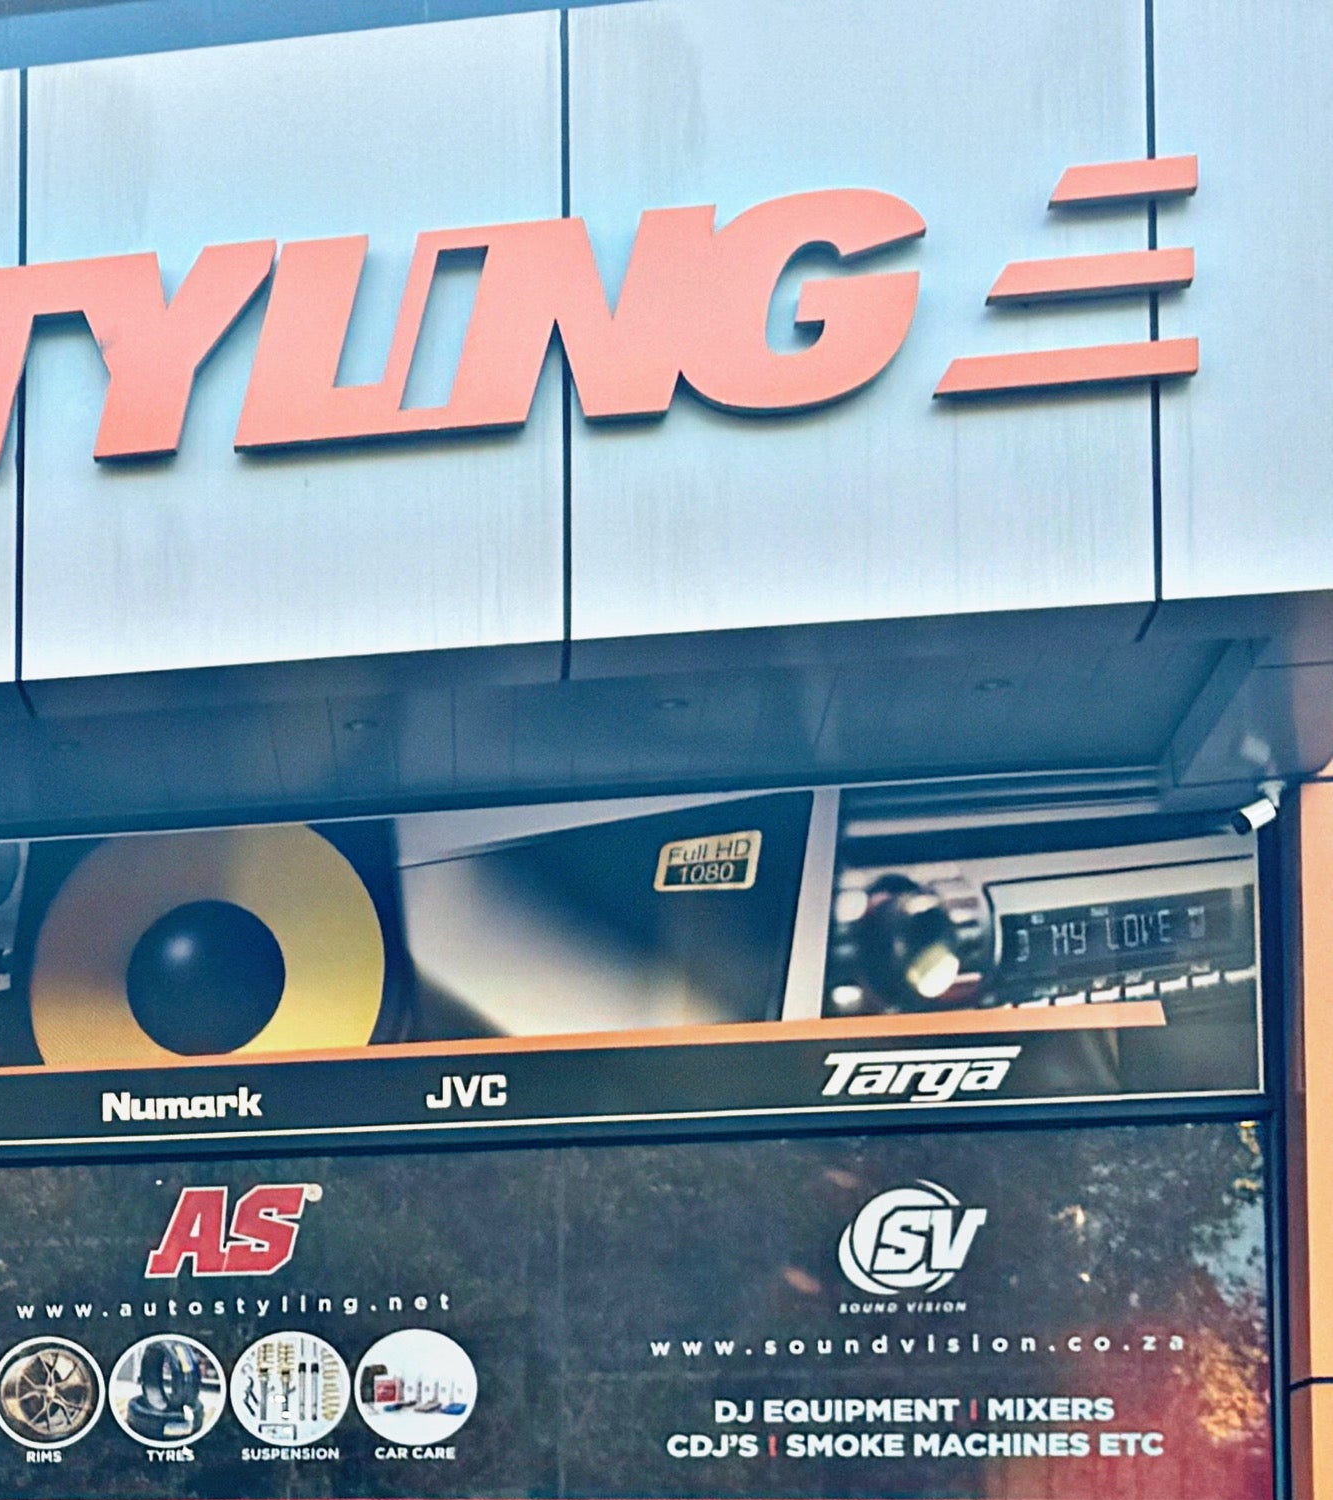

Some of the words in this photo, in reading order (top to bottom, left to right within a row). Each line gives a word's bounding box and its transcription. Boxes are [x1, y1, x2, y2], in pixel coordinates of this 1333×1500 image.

[668, 843, 708, 863] Full
[716, 839, 752, 859] HD
[680, 862, 735, 884] 1080
[1051, 921, 1086, 956] MY
[821, 1045, 1022, 1103] Targa
[102, 1087, 263, 1121] Numark
[426, 1074, 508, 1110] JVC
[143, 1182, 310, 1278] AS
[16, 1293, 451, 1320] www.autostyling.net
[839, 1302, 899, 1314] SOUND
[906, 1301, 967, 1313] VISION
[651, 1334, 1185, 1357] www.soundvision.co.za
[715, 1400, 755, 1424] DJ
[763, 1399, 960, 1423] EQUIPMENT
[988, 1397, 1115, 1421] MIXERS
[26, 1450, 63, 1464] RIMS
[146, 1449, 195, 1463] TYRES
[241, 1447, 340, 1462] SUSPENSION
[374, 1447, 409, 1461] CAR
[412, 1446, 456, 1460] CARE
[666, 1434, 759, 1458] CDJ'S
[786, 1434, 904, 1458] SMOKE
[913, 1433, 1091, 1458] MACHINES
[1099, 1432, 1165, 1457] ETC
